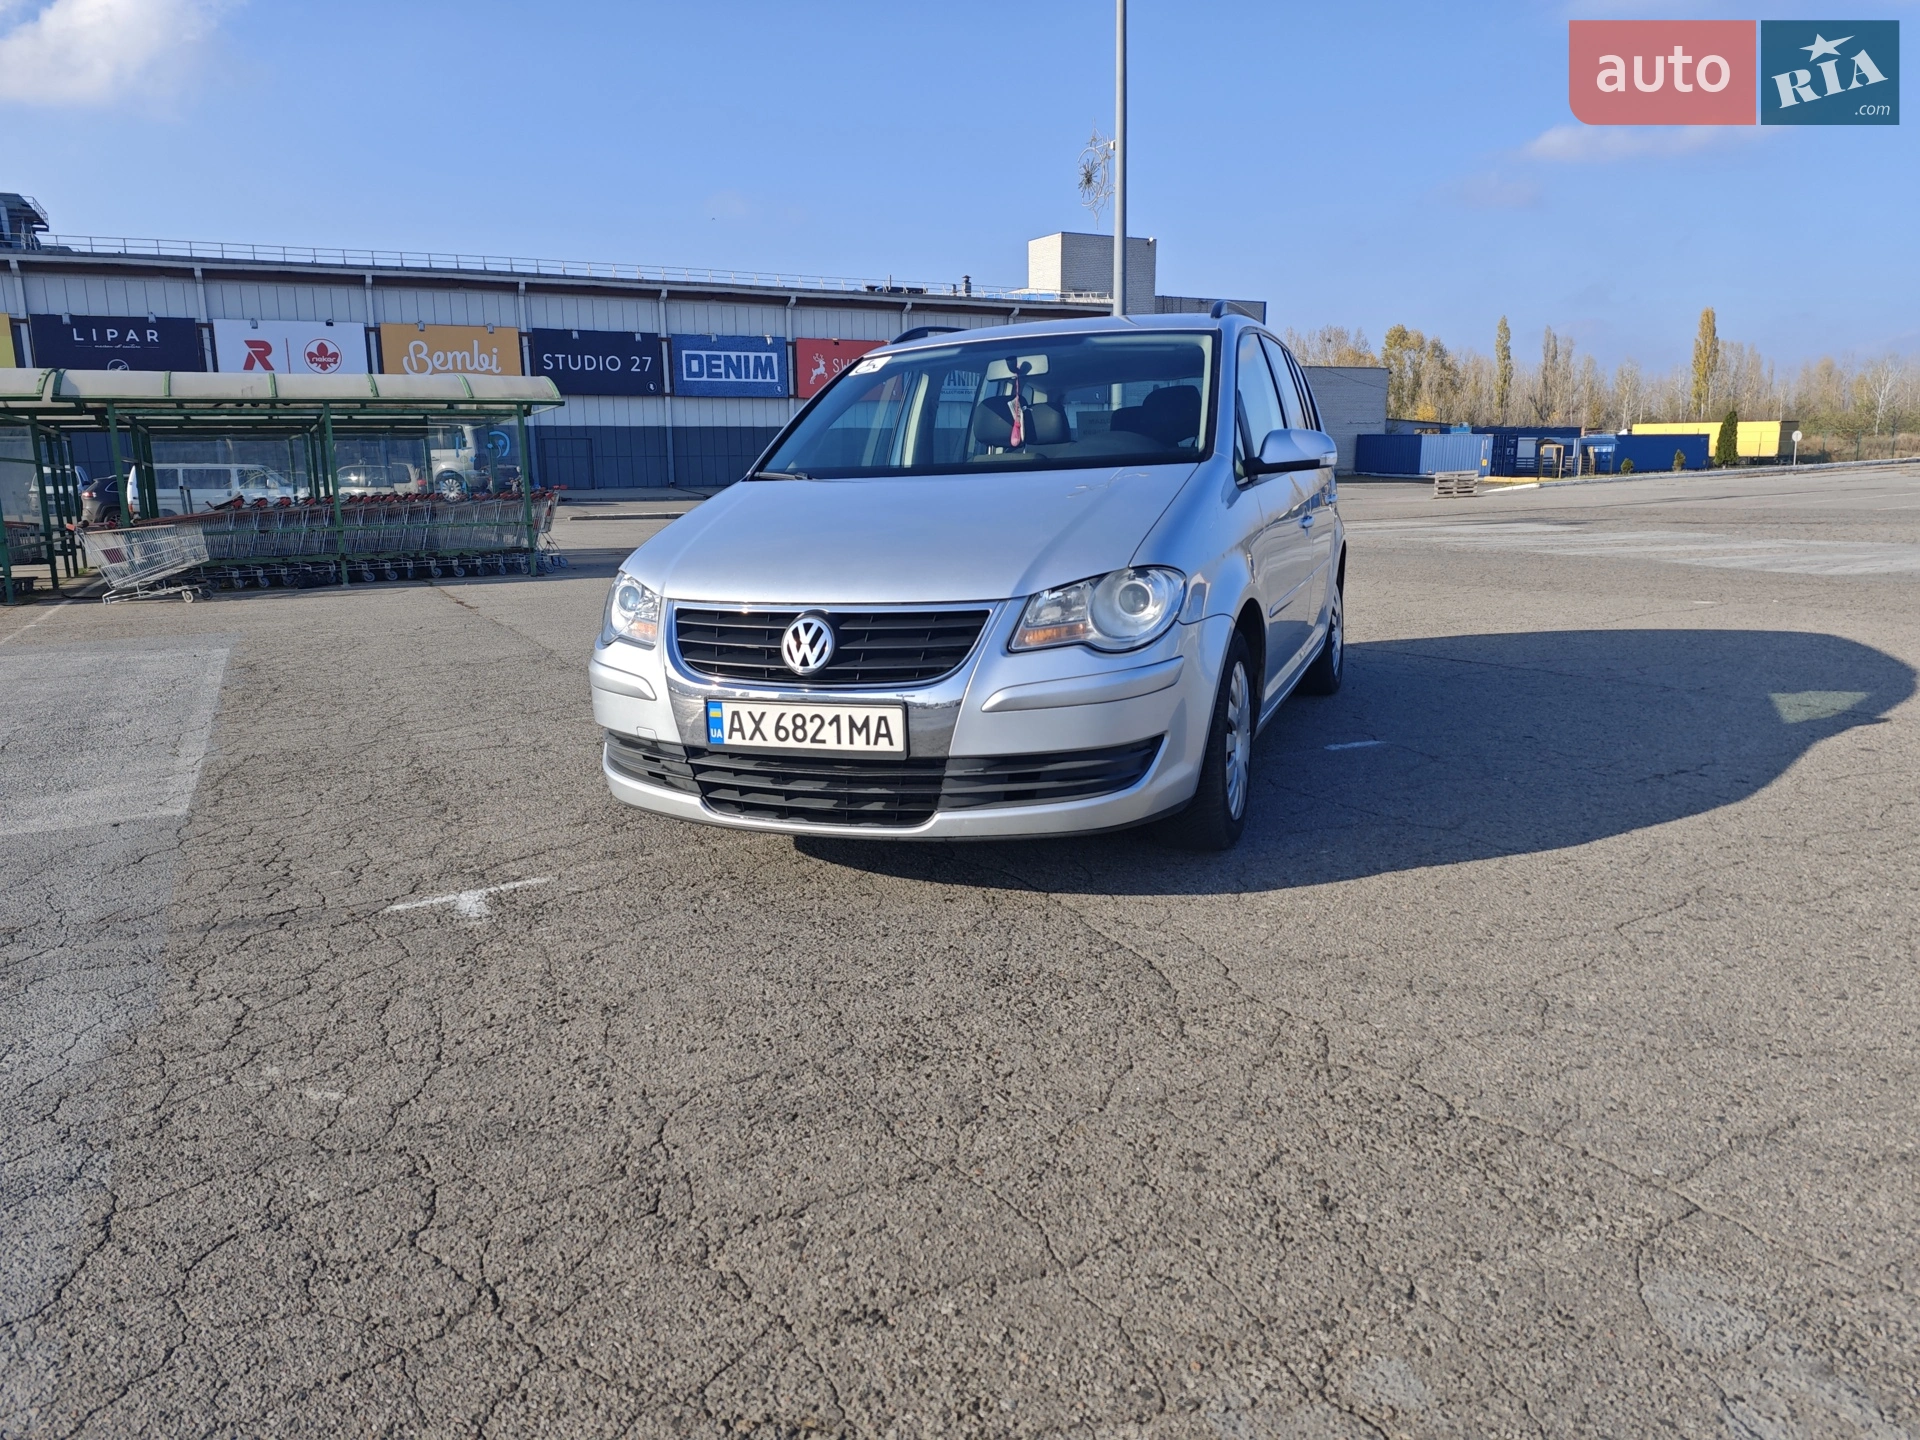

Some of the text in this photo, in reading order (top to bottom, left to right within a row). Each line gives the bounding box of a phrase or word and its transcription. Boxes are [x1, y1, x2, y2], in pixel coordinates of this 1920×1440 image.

[73, 327, 159, 343] LIPAR
[402, 340, 502, 375] Bembi
[543, 353, 652, 373] STUDIO 27
[684, 352, 776, 380] DENIM
[711, 728, 723, 739] UA
[727, 710, 894, 746] AX 6821 MA
